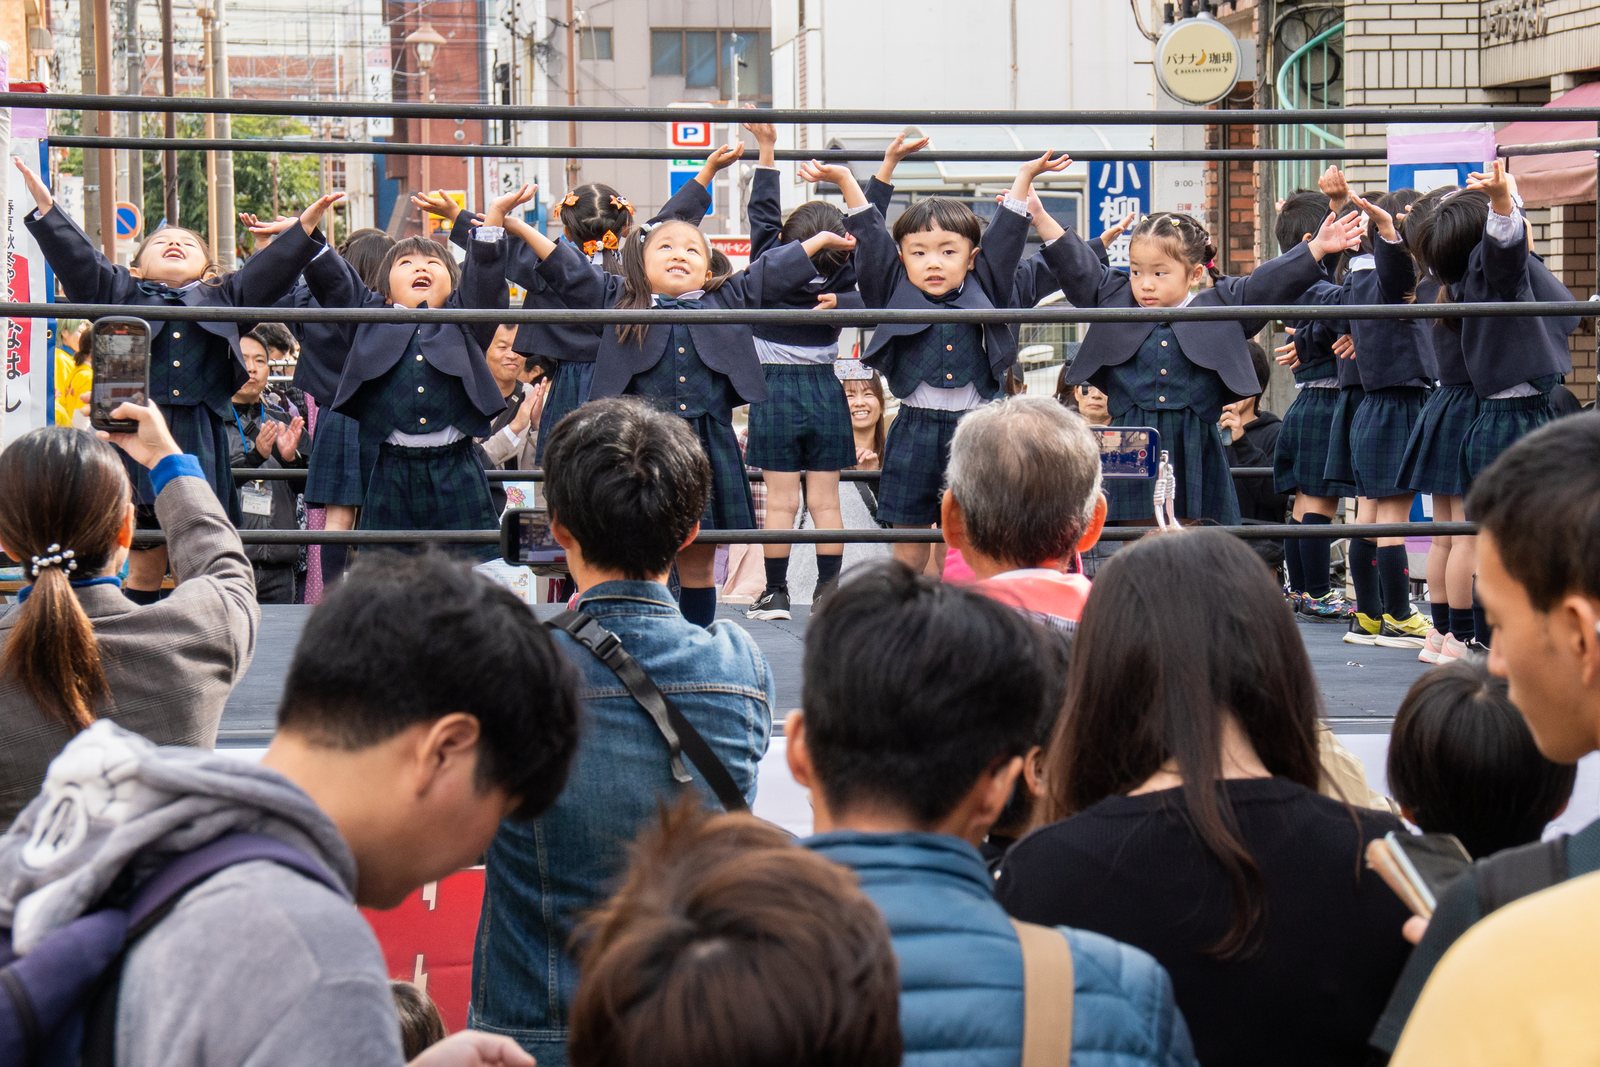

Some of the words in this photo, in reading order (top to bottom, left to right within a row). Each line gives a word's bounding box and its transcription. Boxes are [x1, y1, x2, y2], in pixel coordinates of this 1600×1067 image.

[1166, 53, 1196, 65] バナナ
[1208, 51, 1232, 64] 珈琲
[682, 126, 698, 139] P
